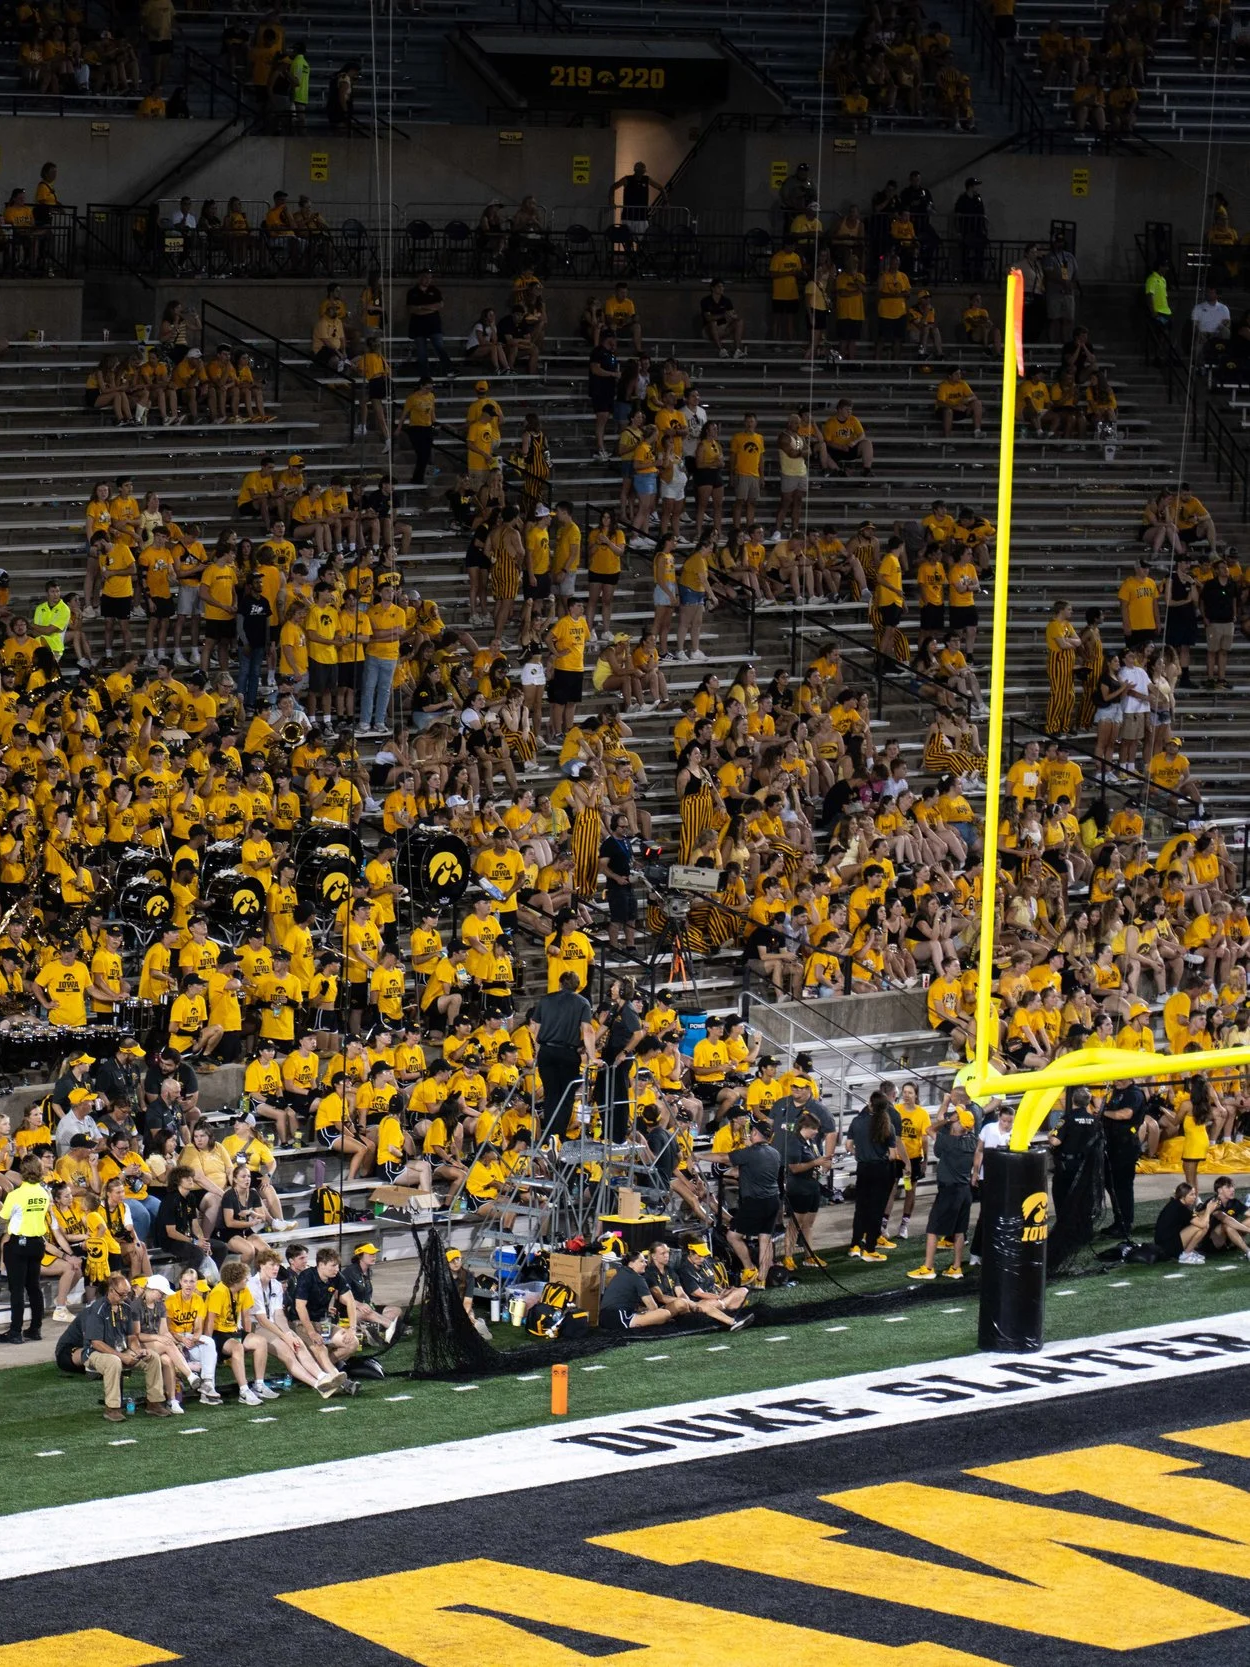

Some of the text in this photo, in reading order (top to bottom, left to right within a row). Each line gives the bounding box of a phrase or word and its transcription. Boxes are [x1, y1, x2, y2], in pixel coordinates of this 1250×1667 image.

[550, 66, 665, 88] 219 220
[1136, 587, 1153, 598] IOWA
[326, 797, 344, 805] IOWA
[492, 868, 511, 876] IOWA
[565, 948, 583, 957] IOWA
[495, 972, 509, 980] IOWA
[58, 981, 78, 989] IOWA
[385, 986, 402, 995] IOWA
[1021, 1226, 1048, 1242] IOW
[554, 1331, 1250, 1456] DUKE SLATER
